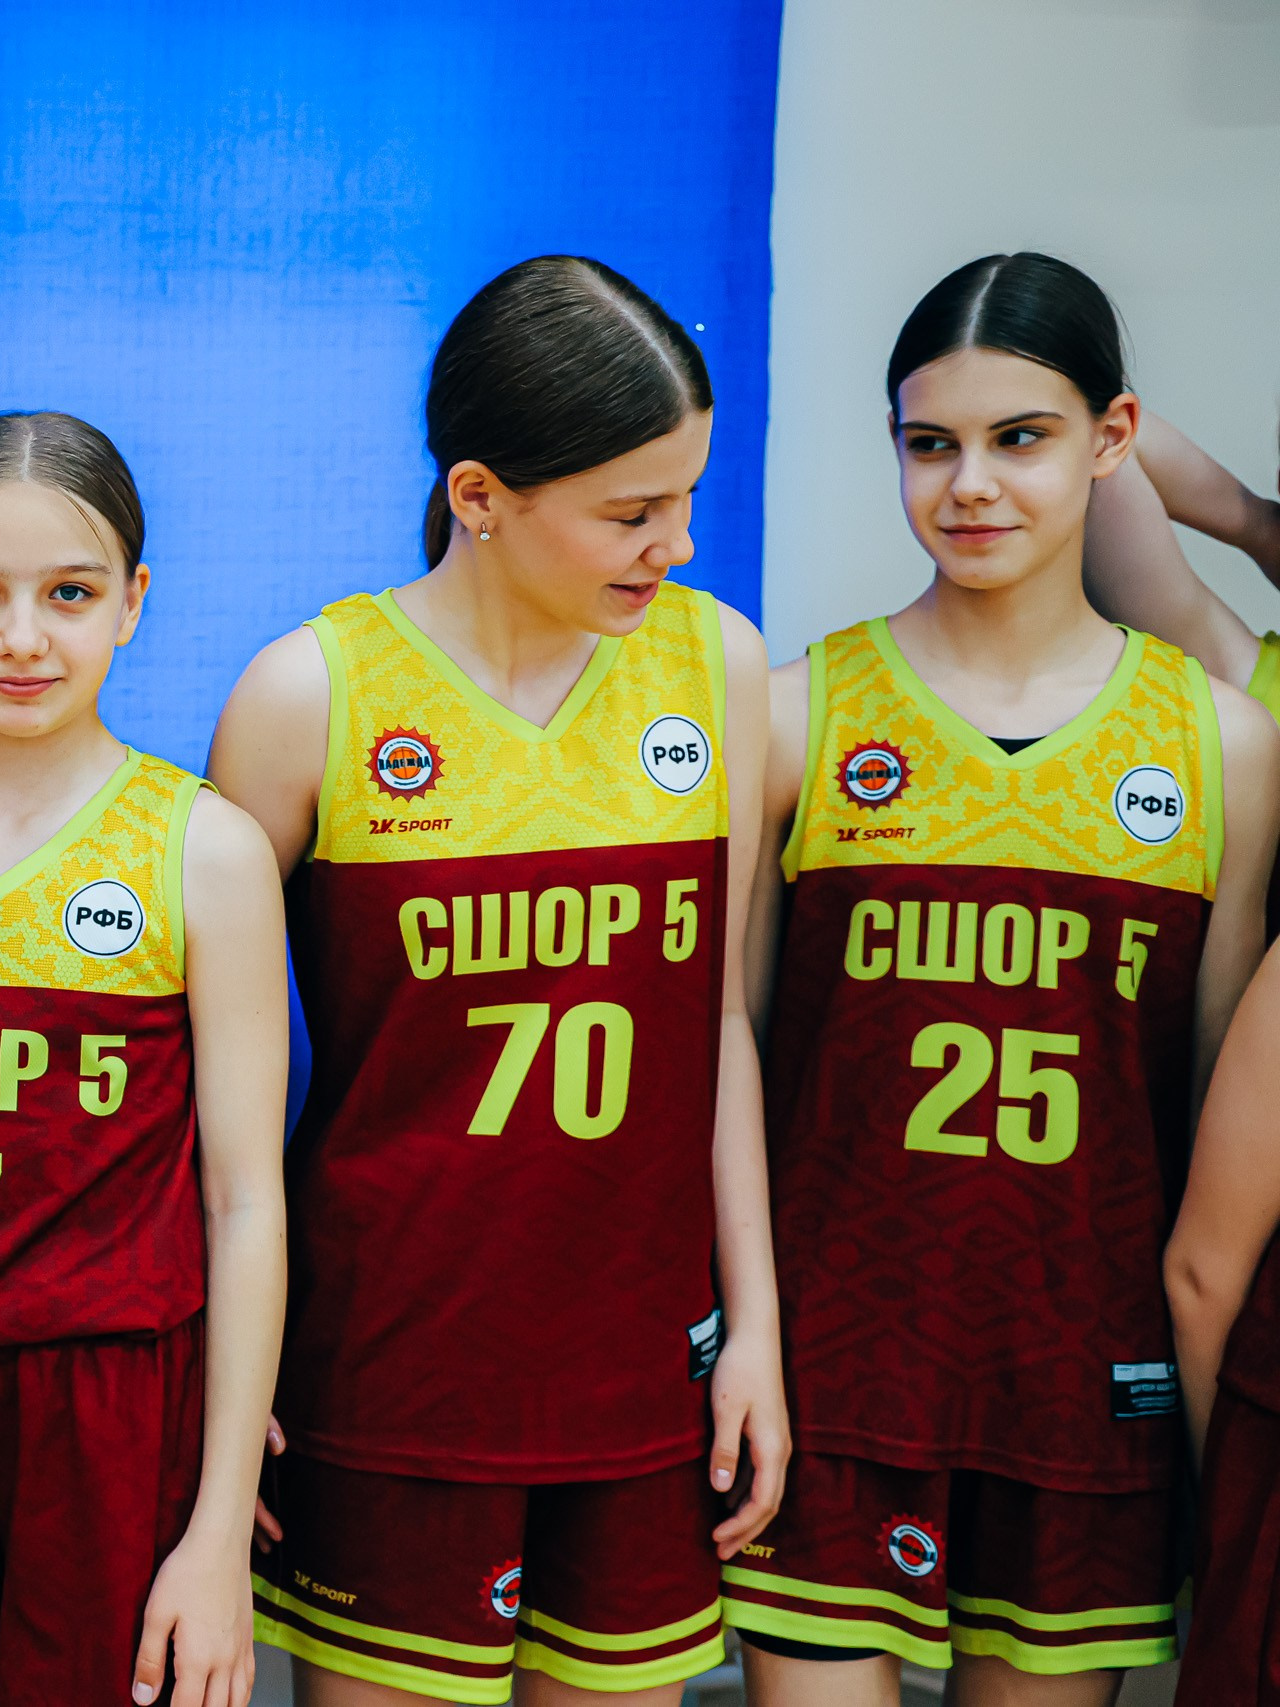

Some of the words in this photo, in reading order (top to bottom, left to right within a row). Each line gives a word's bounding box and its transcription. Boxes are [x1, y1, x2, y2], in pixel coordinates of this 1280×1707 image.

[653, 743, 699, 765] РФБ
[1127, 792, 1177, 817] РФБ
[369, 818, 396, 835] 2K
[398, 818, 453, 833] SPORT
[862, 827, 916, 841] SPORT
[75, 906, 133, 930] РФБ
[399, 884, 640, 980] СШОР
[662, 878, 699, 963] 5
[845, 900, 1090, 989] СШОР
[1115, 918, 1159, 1001] 5
[79, 1035, 128, 1117] 5
[467, 1002, 634, 1139] 70
[904, 1022, 1080, 1164] 25
[312, 1582, 357, 1605] SPORT
